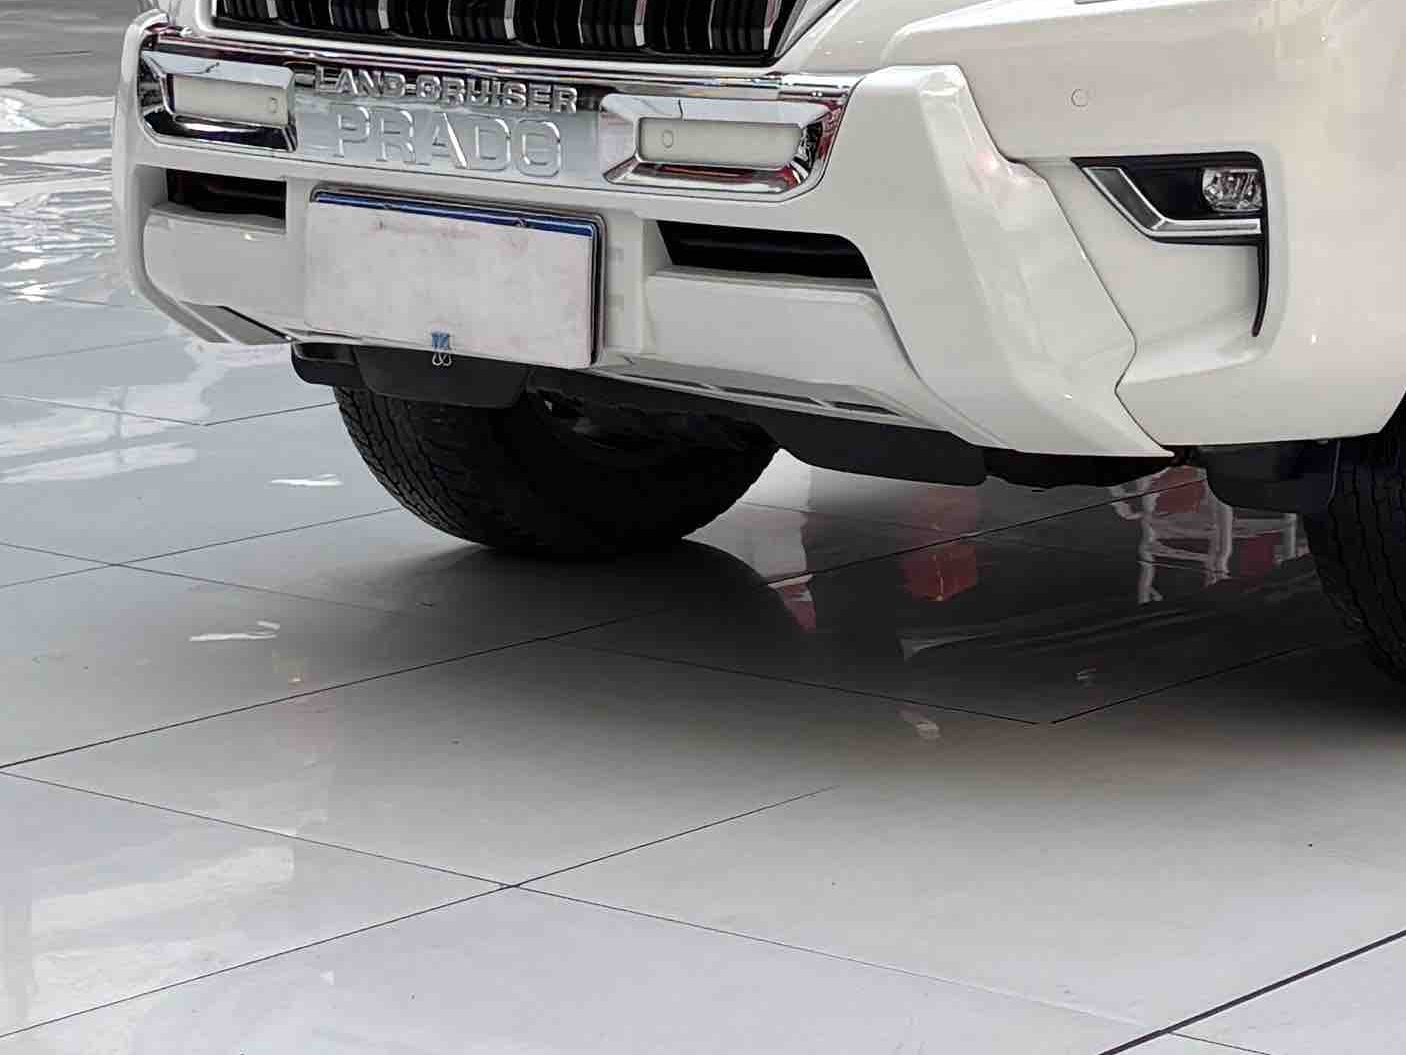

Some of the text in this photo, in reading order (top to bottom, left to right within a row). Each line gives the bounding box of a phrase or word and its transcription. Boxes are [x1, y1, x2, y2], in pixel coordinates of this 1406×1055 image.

[315, 64, 578, 114] LAND CRUISER
[330, 102, 562, 178] PRADO
